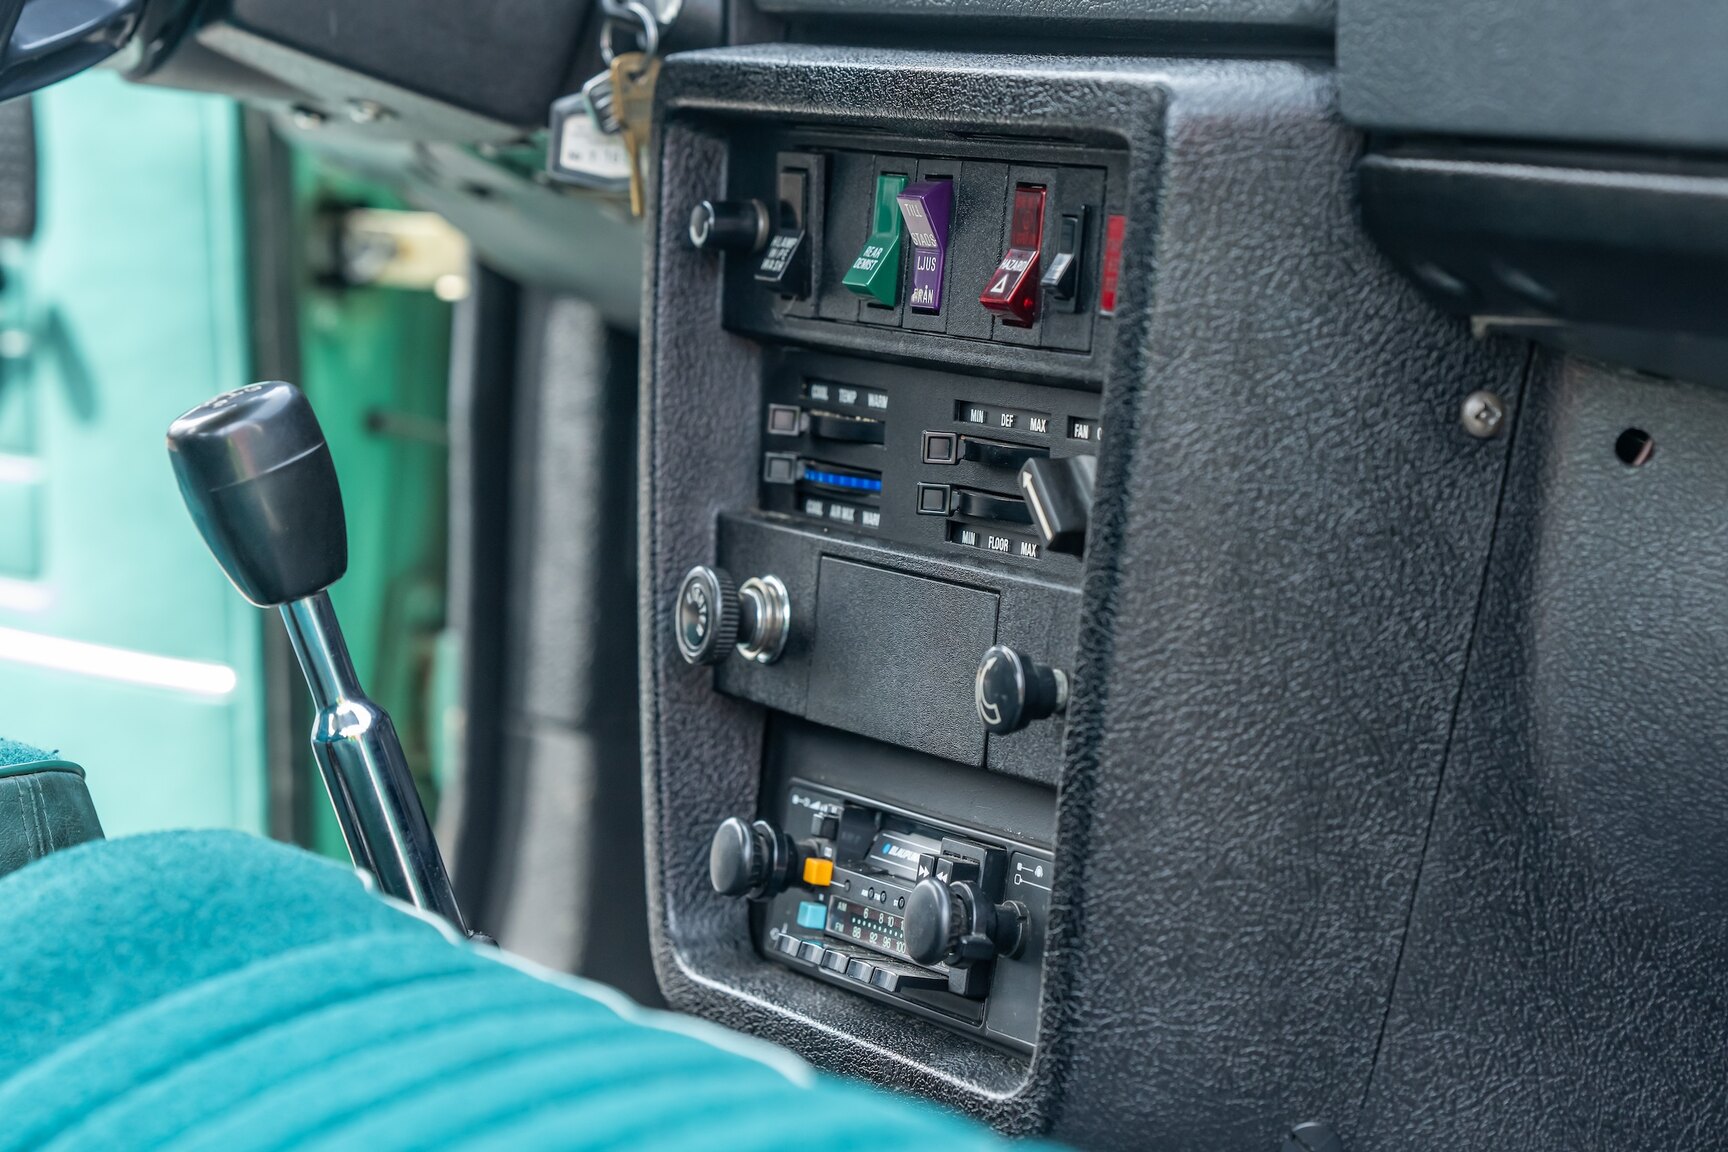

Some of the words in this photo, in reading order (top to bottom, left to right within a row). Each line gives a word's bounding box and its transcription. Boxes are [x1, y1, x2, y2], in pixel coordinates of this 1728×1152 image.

[904, 203, 923, 218] TILL
[910, 232, 937, 248] STADS
[863, 246, 883, 258] REAR
[853, 258, 878, 271] DEMIST
[917, 256, 937, 271] LJUS
[998, 258, 1028, 272] HAZARD
[970, 408, 984, 424] MIN
[1001, 413, 1014, 428] DEF
[1030, 418, 1046, 433] MAX
[1074, 424, 1089, 440] FAN
[962, 530, 976, 546] MIN
[988, 535, 1009, 552] FLOOR
[1021, 542, 1037, 558] MAX
[837, 901, 847, 912] AM
[863, 908, 869, 919] 6
[879, 912, 884, 924] 8
[887, 916, 895, 927] 10
[834, 922, 845, 932] FM
[852, 926, 861, 939] 88
[869, 932, 878, 944] 92
[883, 937, 891, 949] 96
[896, 941, 906, 954] 100
